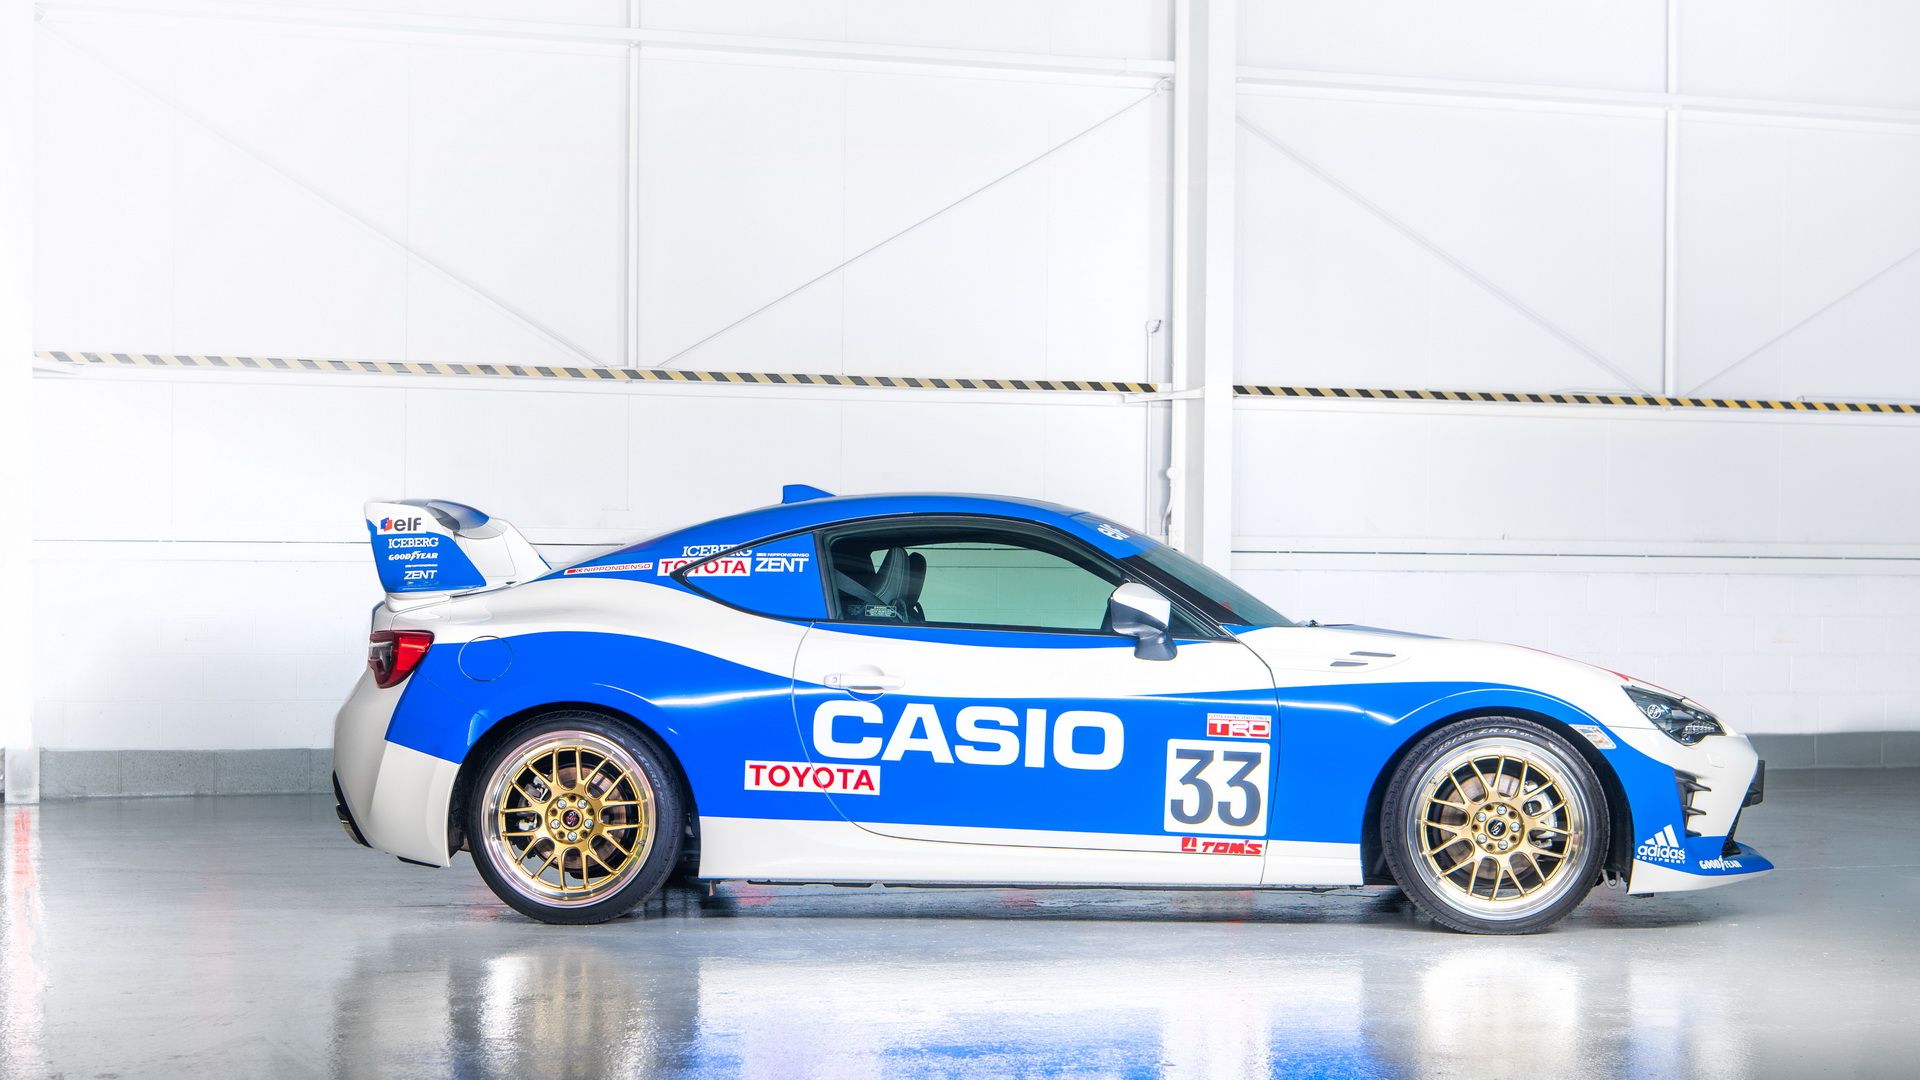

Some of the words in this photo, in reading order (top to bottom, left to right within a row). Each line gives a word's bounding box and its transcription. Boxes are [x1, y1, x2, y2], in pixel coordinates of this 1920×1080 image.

[394, 517, 421, 531] elf
[388, 538, 439, 548] ICEBERG
[388, 551, 439, 561] GOODYEAR
[755, 557, 809, 572] ZENT
[404, 570, 437, 580] ZENT
[813, 700, 1125, 770] CASIO
[1208, 719, 1270, 738] TRD
[749, 764, 875, 791] TOYOTA
[1171, 748, 1262, 827] 33
[1202, 840, 1263, 854] TOM'S
[1637, 844, 1686, 860] adidas
[1699, 855, 1742, 871] GOODYEAR
